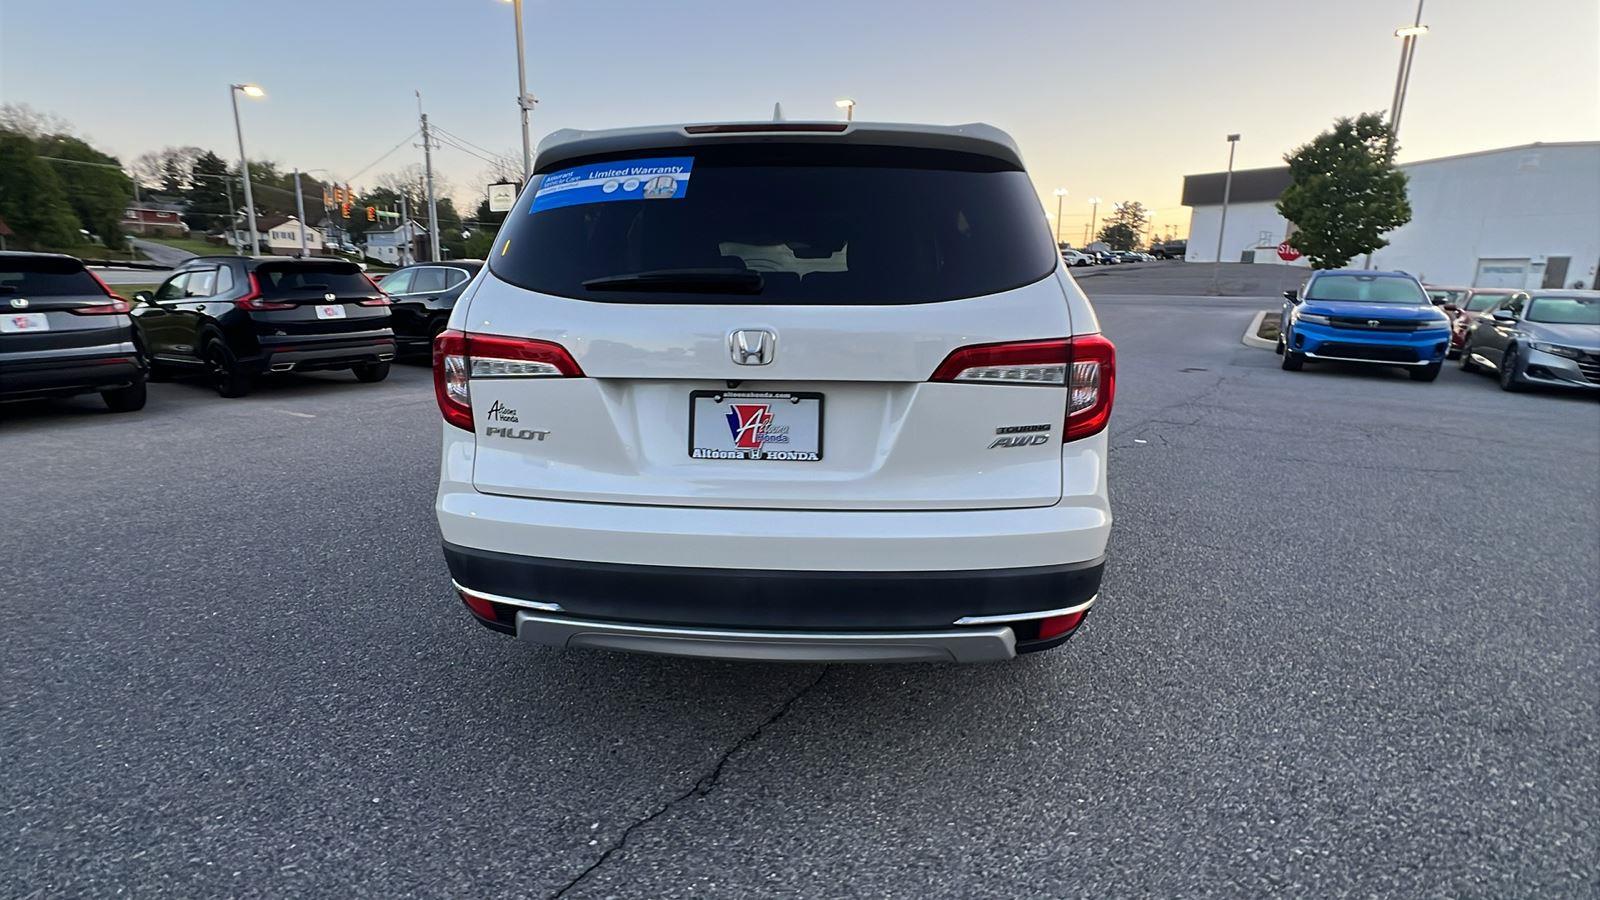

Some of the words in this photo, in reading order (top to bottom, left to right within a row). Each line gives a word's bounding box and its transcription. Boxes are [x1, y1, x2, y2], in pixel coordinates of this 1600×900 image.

[588, 168, 629, 180] Limited
[630, 165, 684, 176] Warranty
[485, 426, 551, 442] PILOT
[995, 423, 1052, 435] TOURING
[756, 432, 790, 444] Honda
[987, 433, 1050, 450] AWD
[692, 448, 745, 460] Altoona
[766, 451, 819, 461] HONDA
